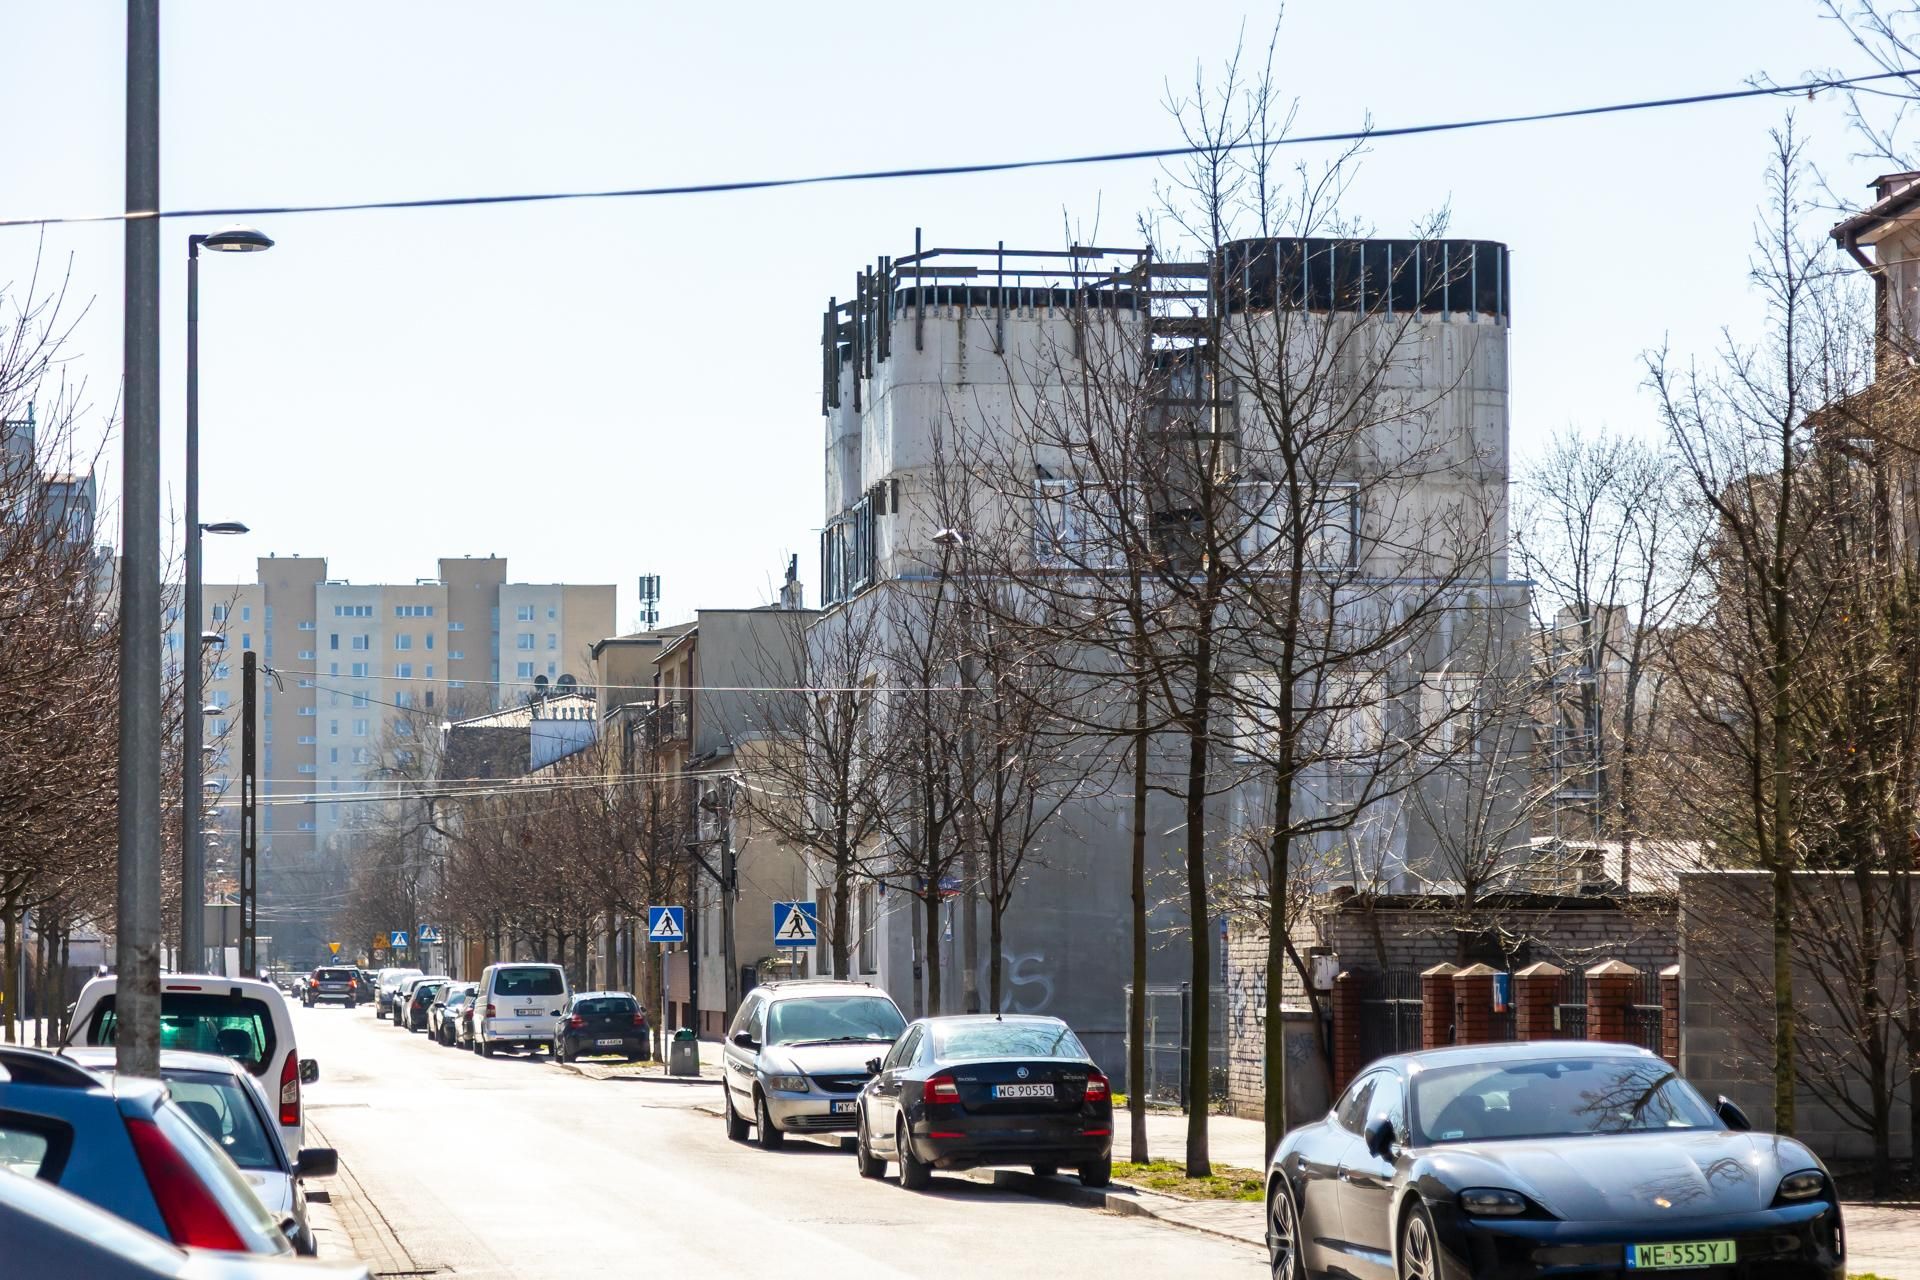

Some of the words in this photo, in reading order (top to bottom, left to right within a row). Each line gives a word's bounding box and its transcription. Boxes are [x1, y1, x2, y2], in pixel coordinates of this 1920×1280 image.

[999, 1086, 1015, 1097] WG
[1018, 1085, 1053, 1096] 90550
[837, 1103, 850, 1112] WY
[1640, 1245, 1666, 1266] WE
[1672, 1242, 1730, 1264] 555YJ
